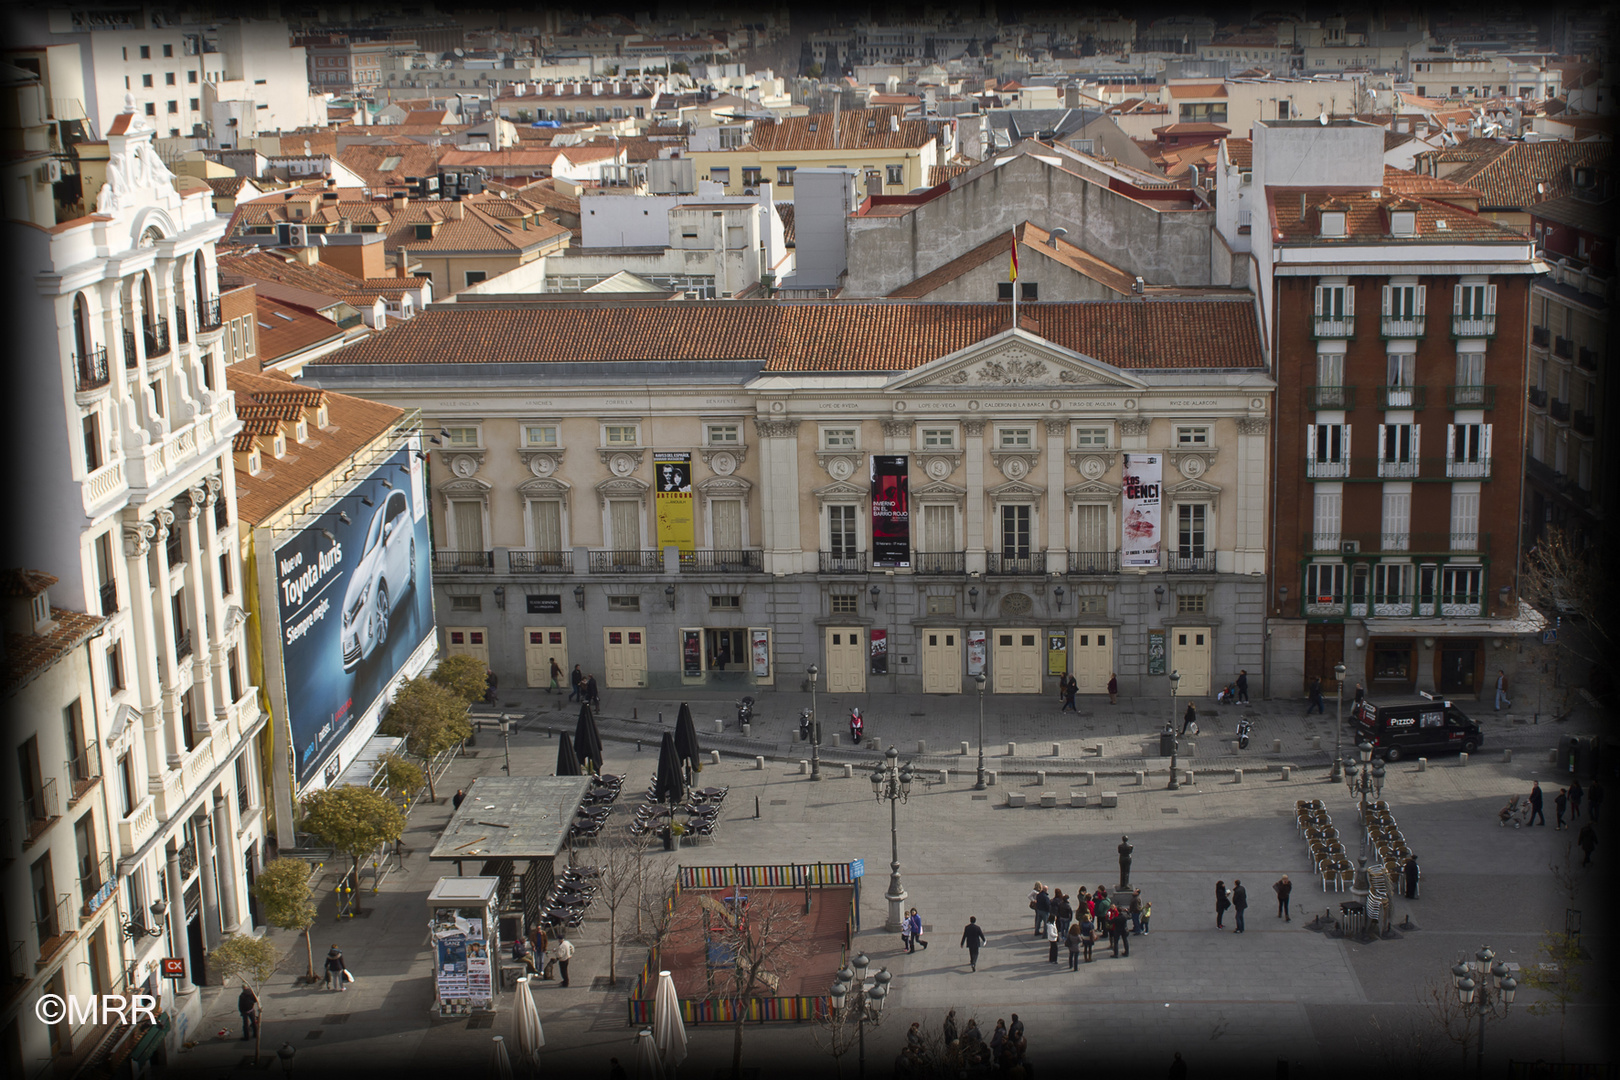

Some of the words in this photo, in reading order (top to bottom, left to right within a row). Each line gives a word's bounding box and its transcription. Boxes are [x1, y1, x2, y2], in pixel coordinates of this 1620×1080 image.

[1127, 476, 1140, 485] LOS
[1127, 484, 1159, 499] CENCI
[282, 564, 319, 607] Toyota
[319, 540, 343, 578] Auris
[286, 614, 314, 645] Siempre
[168, 961, 182, 970] CX
